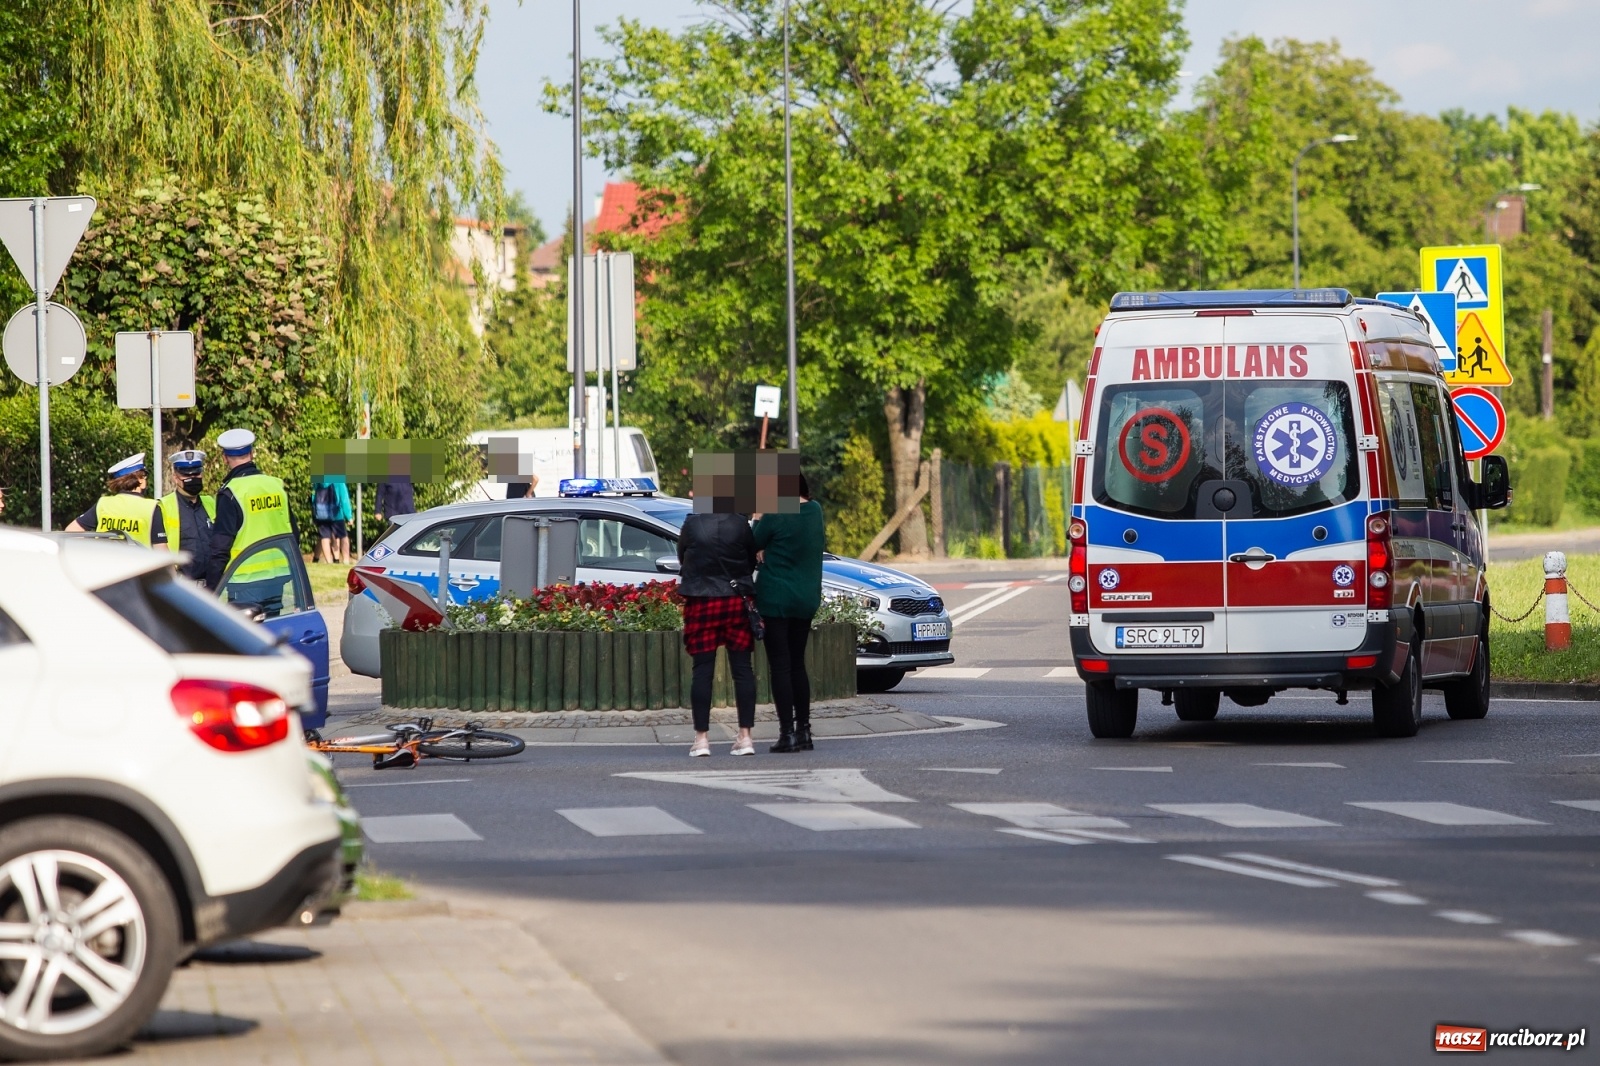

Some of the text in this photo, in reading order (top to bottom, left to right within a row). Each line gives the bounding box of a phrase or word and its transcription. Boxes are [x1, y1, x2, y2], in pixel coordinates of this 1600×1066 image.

[1132, 345, 1309, 380] AMBULANS
[1254, 406, 1335, 462] PAŃSTWOWE RATOWNICTWO
[1138, 423, 1169, 467] S
[1269, 468, 1322, 484] MEDYCZNE
[250, 495, 282, 511] POLICJA
[100, 517, 140, 533] POLICJA
[1335, 590, 1354, 598] TDI
[917, 624, 930, 637] HPP
[1126, 628, 1200, 643] SRC 9LT9
